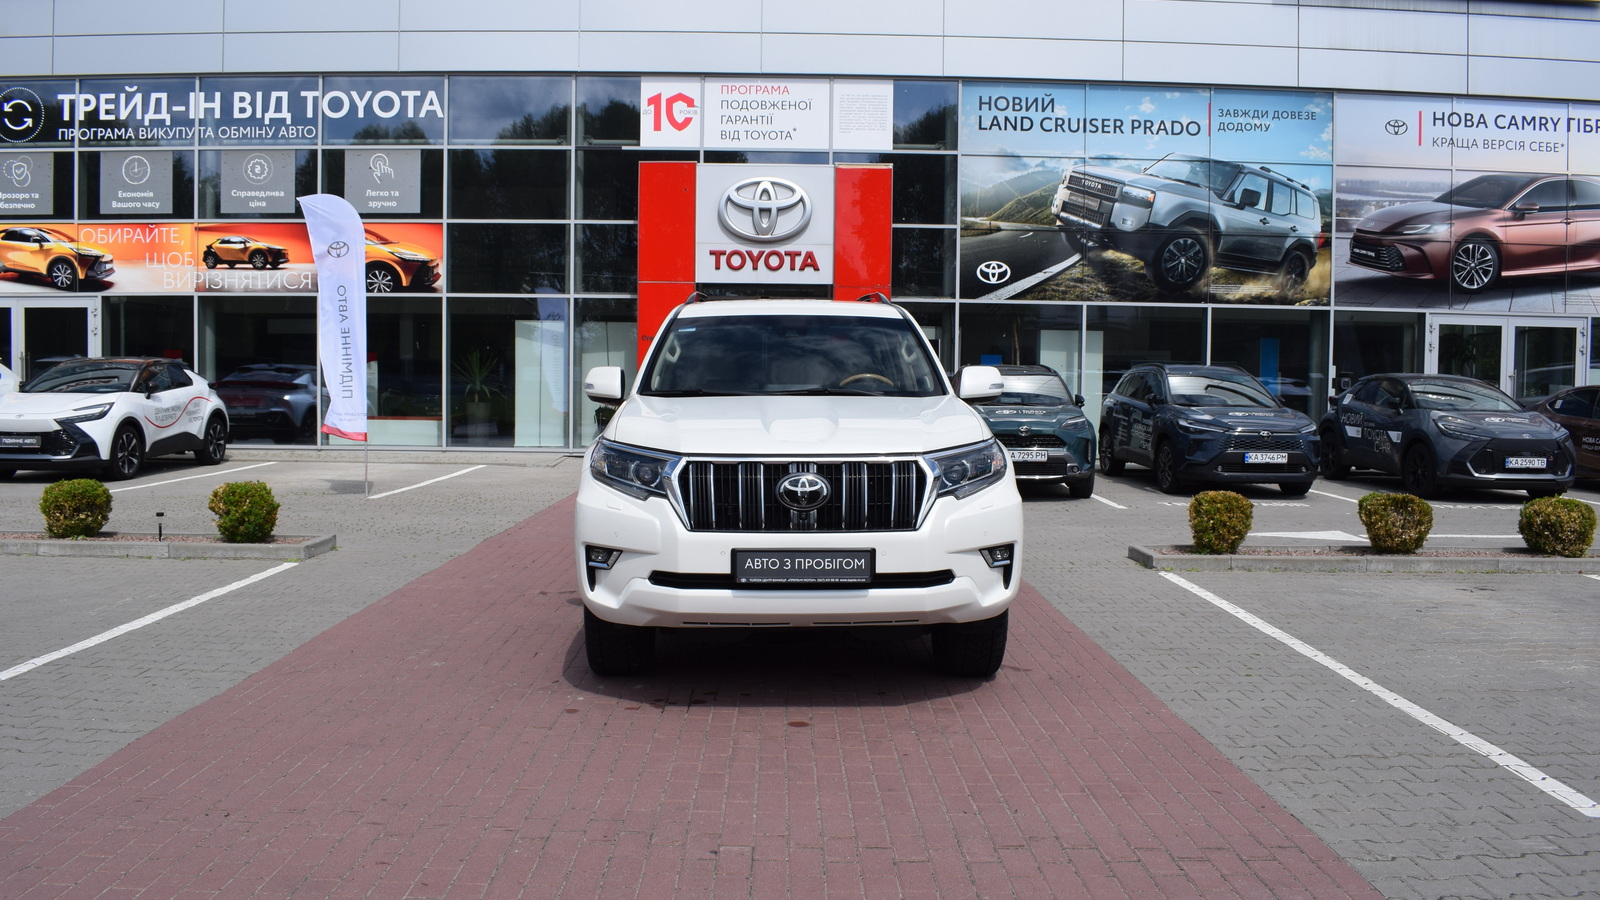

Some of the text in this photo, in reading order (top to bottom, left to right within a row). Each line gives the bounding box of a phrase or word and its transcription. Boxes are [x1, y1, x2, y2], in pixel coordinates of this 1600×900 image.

[720, 84, 790, 95] ПРОГРАМА
[57, 85, 444, 126] ТРЕЙД-ІН ВІД TOYOTA
[720, 98, 812, 112] ПОДОВЖЕНОЇ
[978, 93, 1056, 113] НОВИЙ
[720, 113, 774, 125] ГАРАНТІЇ
[1217, 108, 1317, 121] ЗАВЖДИ ДОВЕЗЕ
[978, 115, 1201, 137] LAND CRUISER PRADO
[1217, 121, 1271, 134] ДОДОМУ
[1432, 111, 1488, 129] НОВА
[1494, 114, 1561, 133] CAMRY
[58, 125, 316, 141] ПРОГРАМА ВИКУПУ ТА ОБМІНУ АВТО
[720, 130, 741, 142] ВІД
[1432, 137, 1479, 151] КРАЩА
[1483, 138, 1525, 151] ВЕРСІЯ
[1081, 179, 1102, 189] TOYOTA
[0, 191, 30, 201] розоро
[118, 190, 154, 199] Економія
[231, 189, 284, 199] Справедлива
[365, 189, 399, 198] Легко та
[112, 201, 160, 210] Вашого часу
[249, 199, 267, 208] ціна
[368, 200, 397, 209] зручно
[80, 225, 185, 246] ОБИРАЙТЕ,
[145, 251, 195, 270] ЩОБ
[709, 249, 820, 271] TOYOTA
[163, 271, 312, 289] ВИРІЗНЯТИСЯ
[1017, 451, 1035, 459] 7295
[1259, 453, 1276, 461] 3746
[1519, 458, 1536, 467] 2590
[744, 558, 780, 570] АВТО
[795, 558, 865, 570] ПРОБІГОМ
